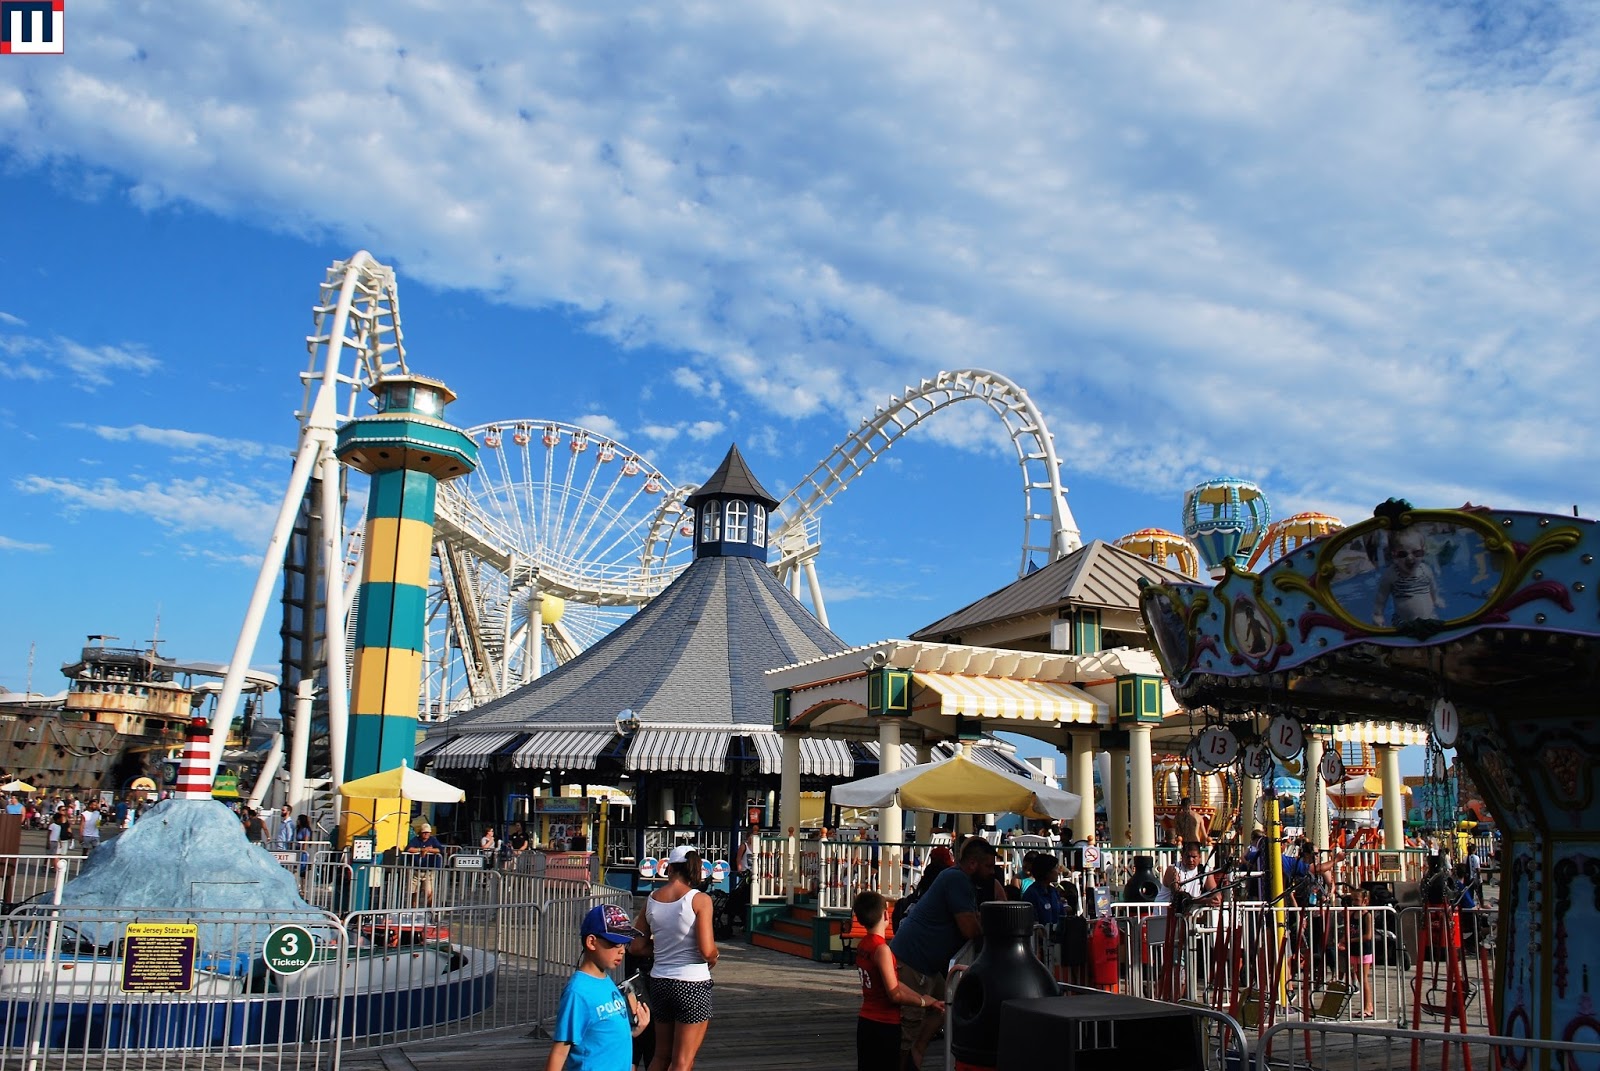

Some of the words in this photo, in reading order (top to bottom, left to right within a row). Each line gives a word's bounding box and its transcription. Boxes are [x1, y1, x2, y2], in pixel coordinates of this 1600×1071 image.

[1442, 708, 1450, 732] 11
[1280, 724, 1294, 747] 12
[1210, 735, 1228, 755] 13
[1249, 751, 1261, 768] 15
[1326, 761, 1336, 774] 16
[142, 926, 162, 935] Jersey
[280, 933, 299, 956] 3
[272, 958, 305, 966] Tickets
